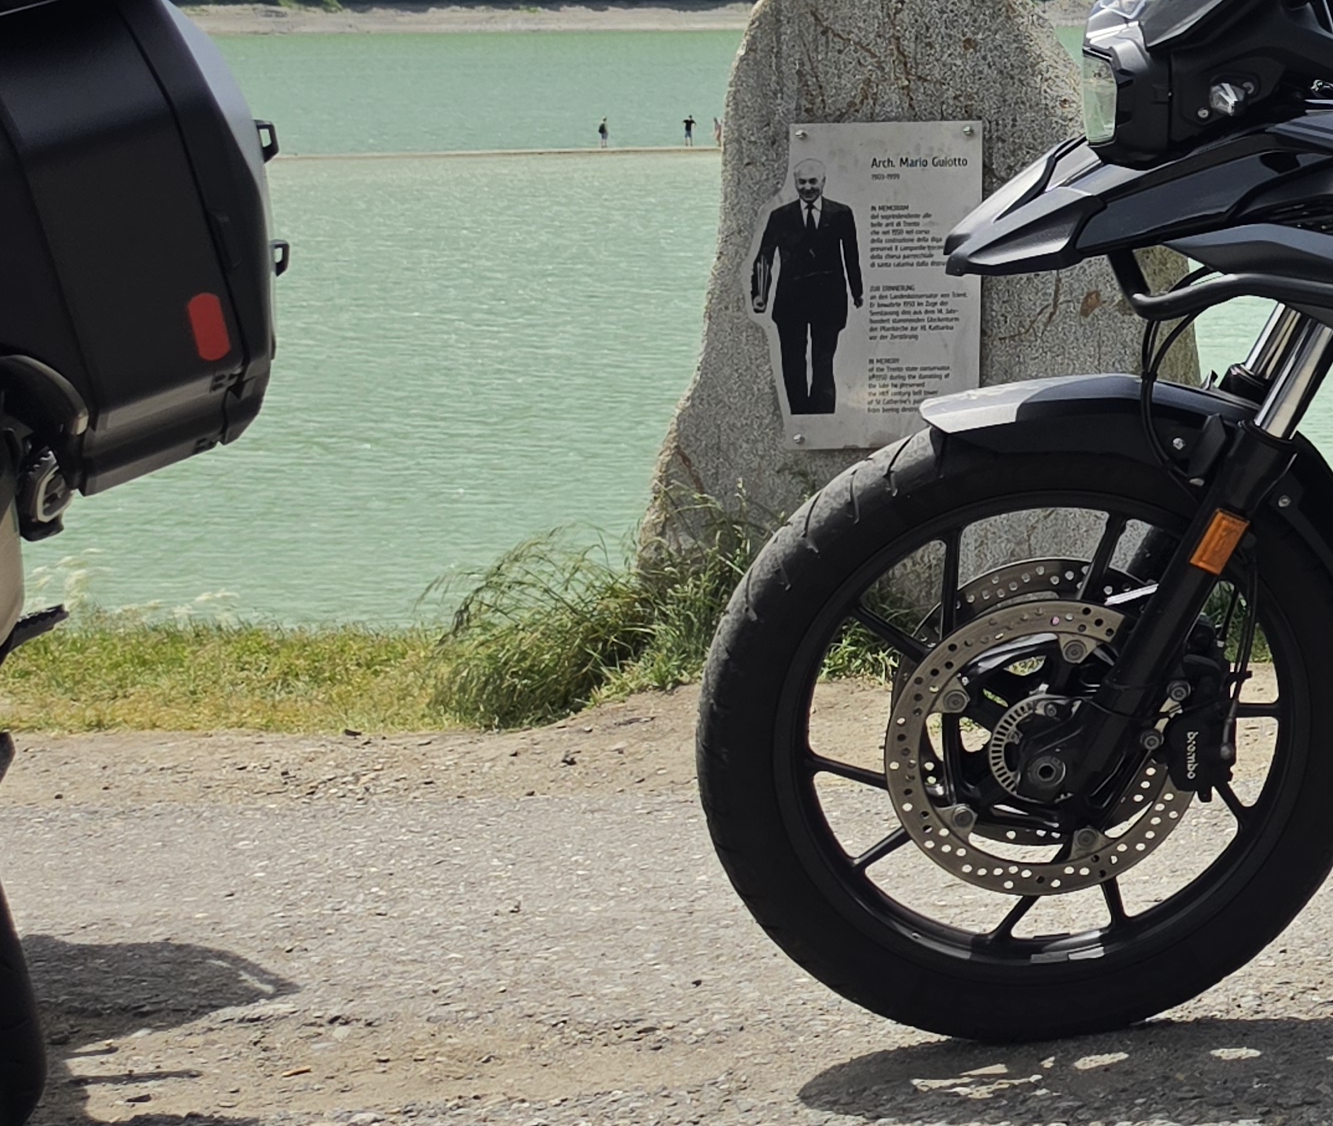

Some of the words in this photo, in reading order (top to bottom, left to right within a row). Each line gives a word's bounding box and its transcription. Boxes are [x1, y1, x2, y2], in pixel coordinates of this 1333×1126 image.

[871, 157, 895, 168] Arch.
[900, 157, 928, 167] Mario
[932, 156, 968, 167] Guiotto
[1187, 731, 1199, 780] brembo
